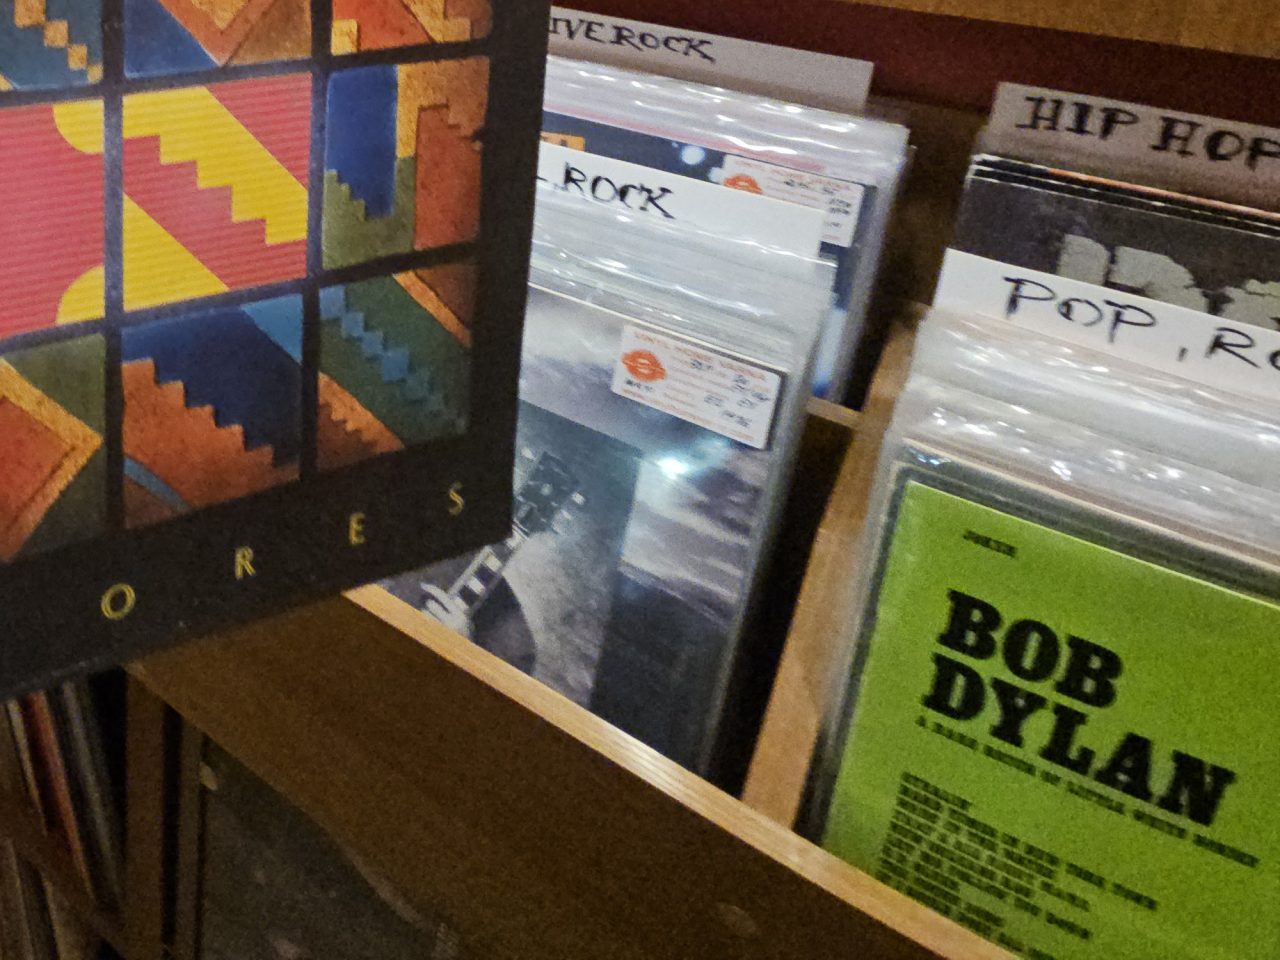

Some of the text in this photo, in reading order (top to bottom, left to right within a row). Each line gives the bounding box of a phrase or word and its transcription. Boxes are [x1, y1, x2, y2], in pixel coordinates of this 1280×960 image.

[611, 25, 716, 64] ROCK
[1015, 95, 1280, 172] HIP HOP
[563, 160, 677, 220] ROCK
[936, 587, 1124, 709] BOB
[921, 650, 1238, 829] DYLAN
